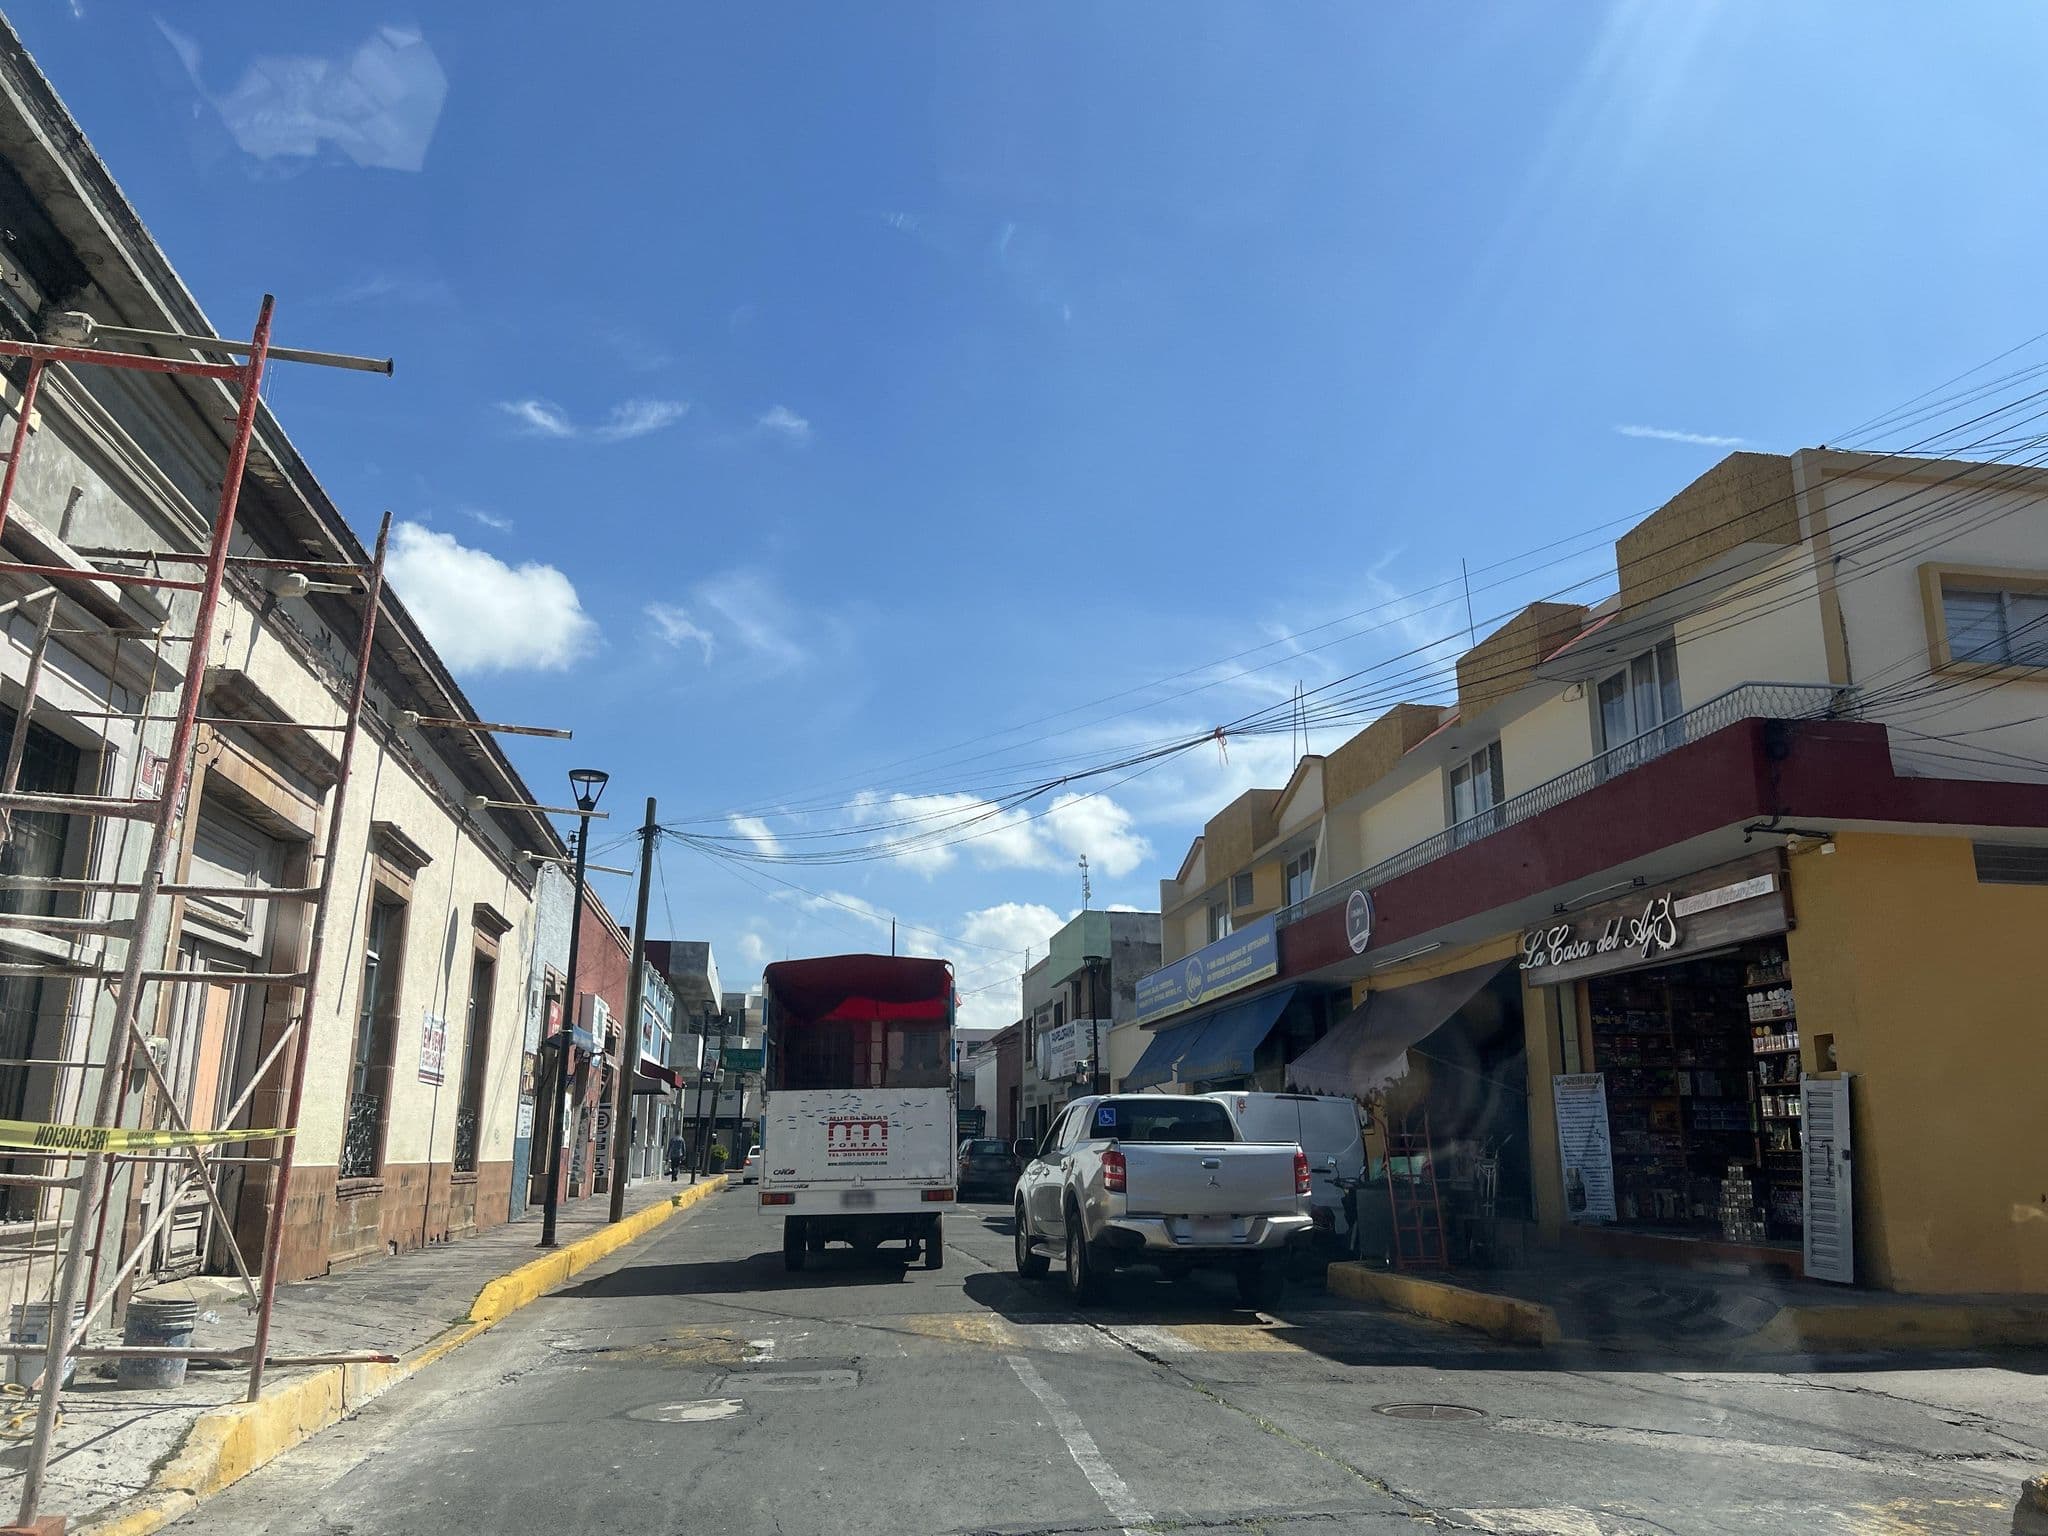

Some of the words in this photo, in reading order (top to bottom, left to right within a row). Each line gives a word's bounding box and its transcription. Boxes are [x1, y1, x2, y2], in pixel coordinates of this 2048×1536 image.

[1519, 929, 1546, 970] La
[1547, 924, 1591, 966] Casa
[1596, 916, 1624, 953] del
